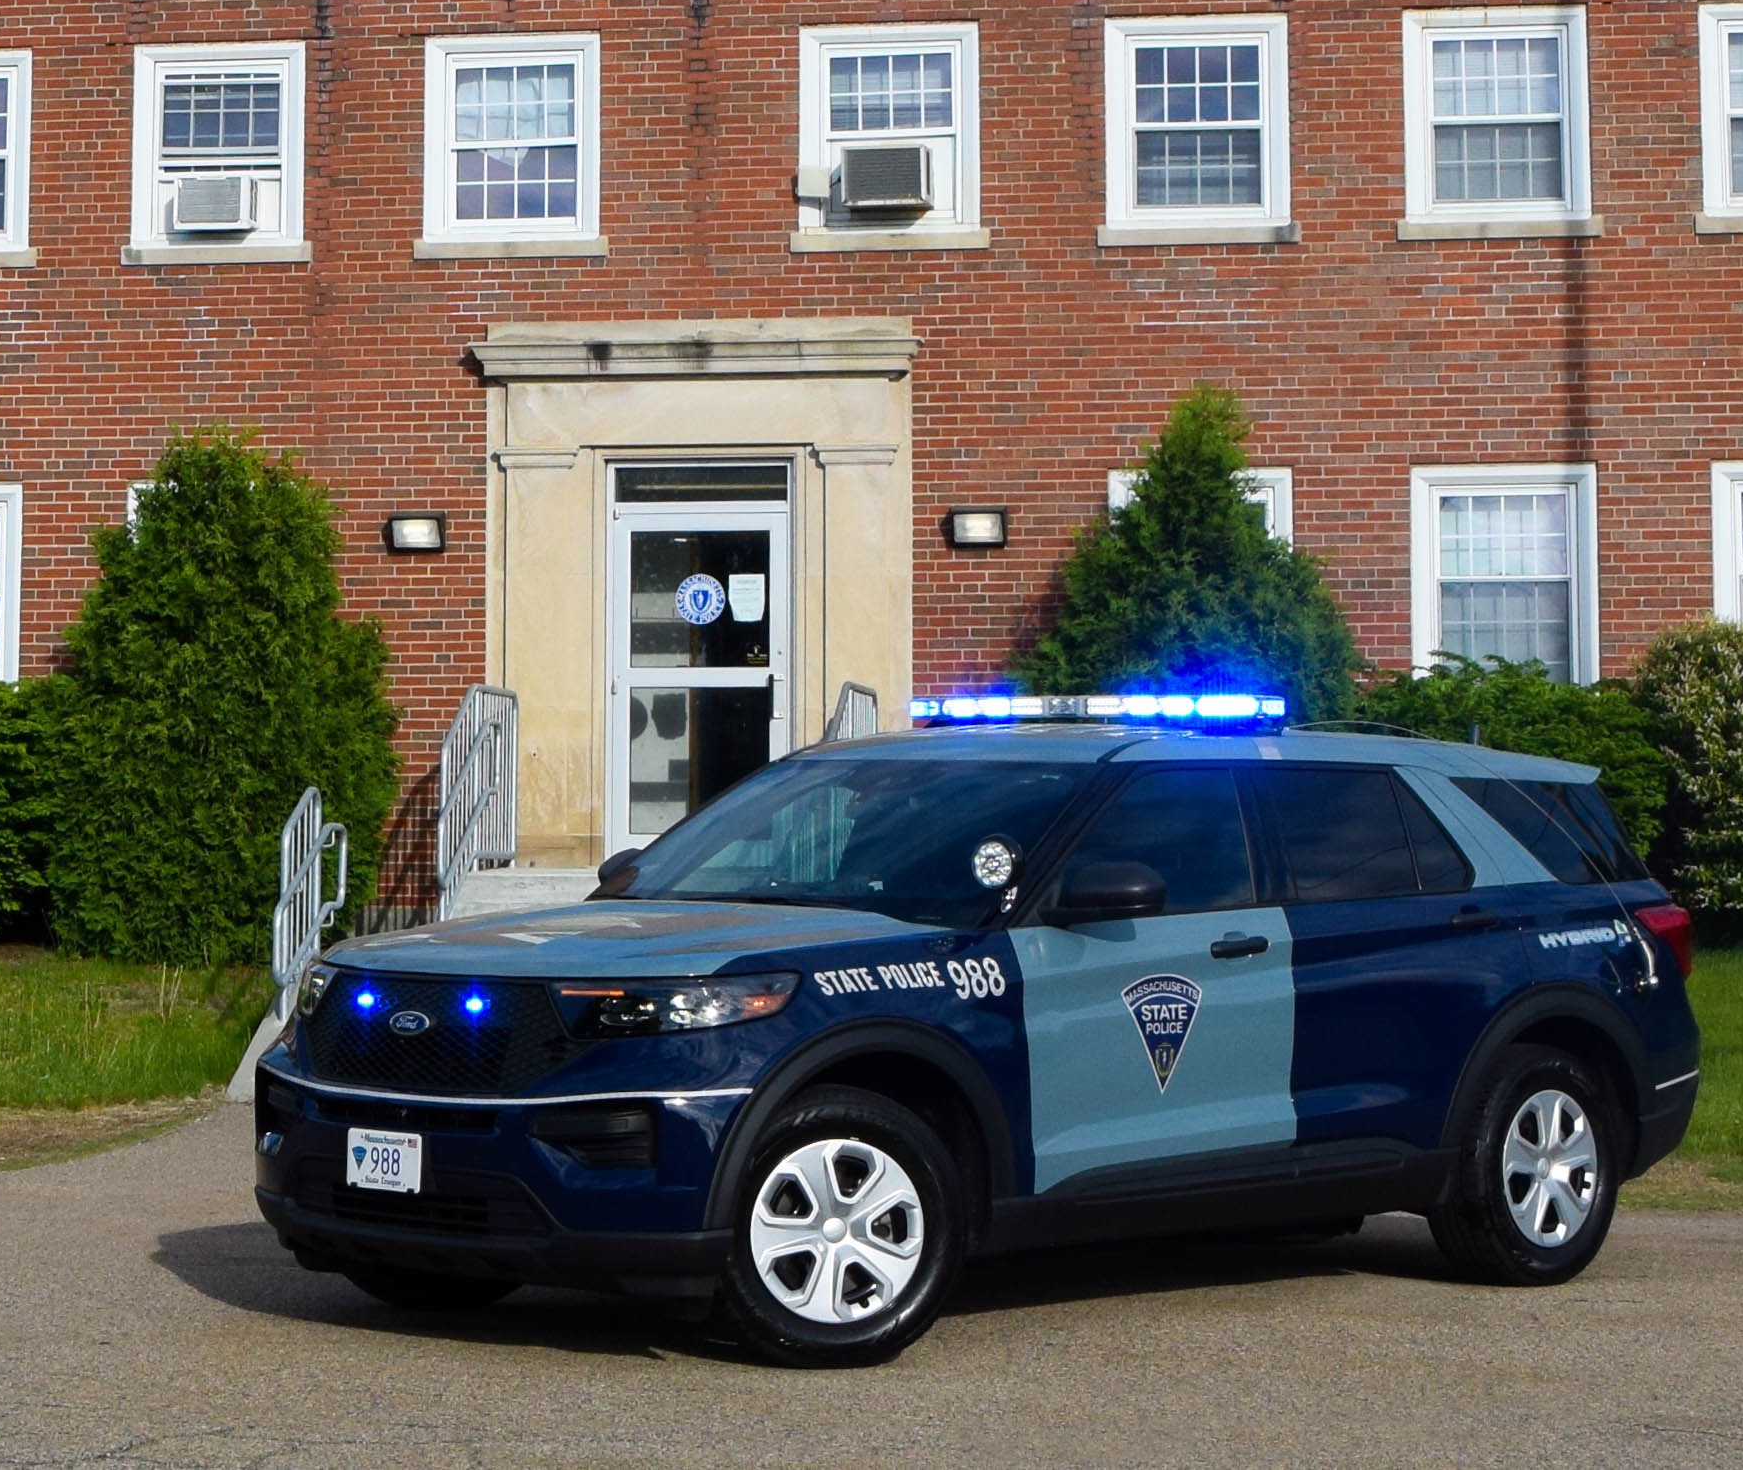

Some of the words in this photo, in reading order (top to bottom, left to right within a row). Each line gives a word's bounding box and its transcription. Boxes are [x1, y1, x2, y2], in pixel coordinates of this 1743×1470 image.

[1538, 927, 1616, 949] HYBRID
[814, 967, 879, 996] STATE
[876, 961, 945, 990] POLICE
[947, 957, 1006, 1000] 988
[1125, 980, 1199, 1003] MASSACHUSETTS
[1141, 1004, 1188, 1021] STATE
[1146, 1022, 1183, 1035] POLICE
[371, 1146, 401, 1176] 988
